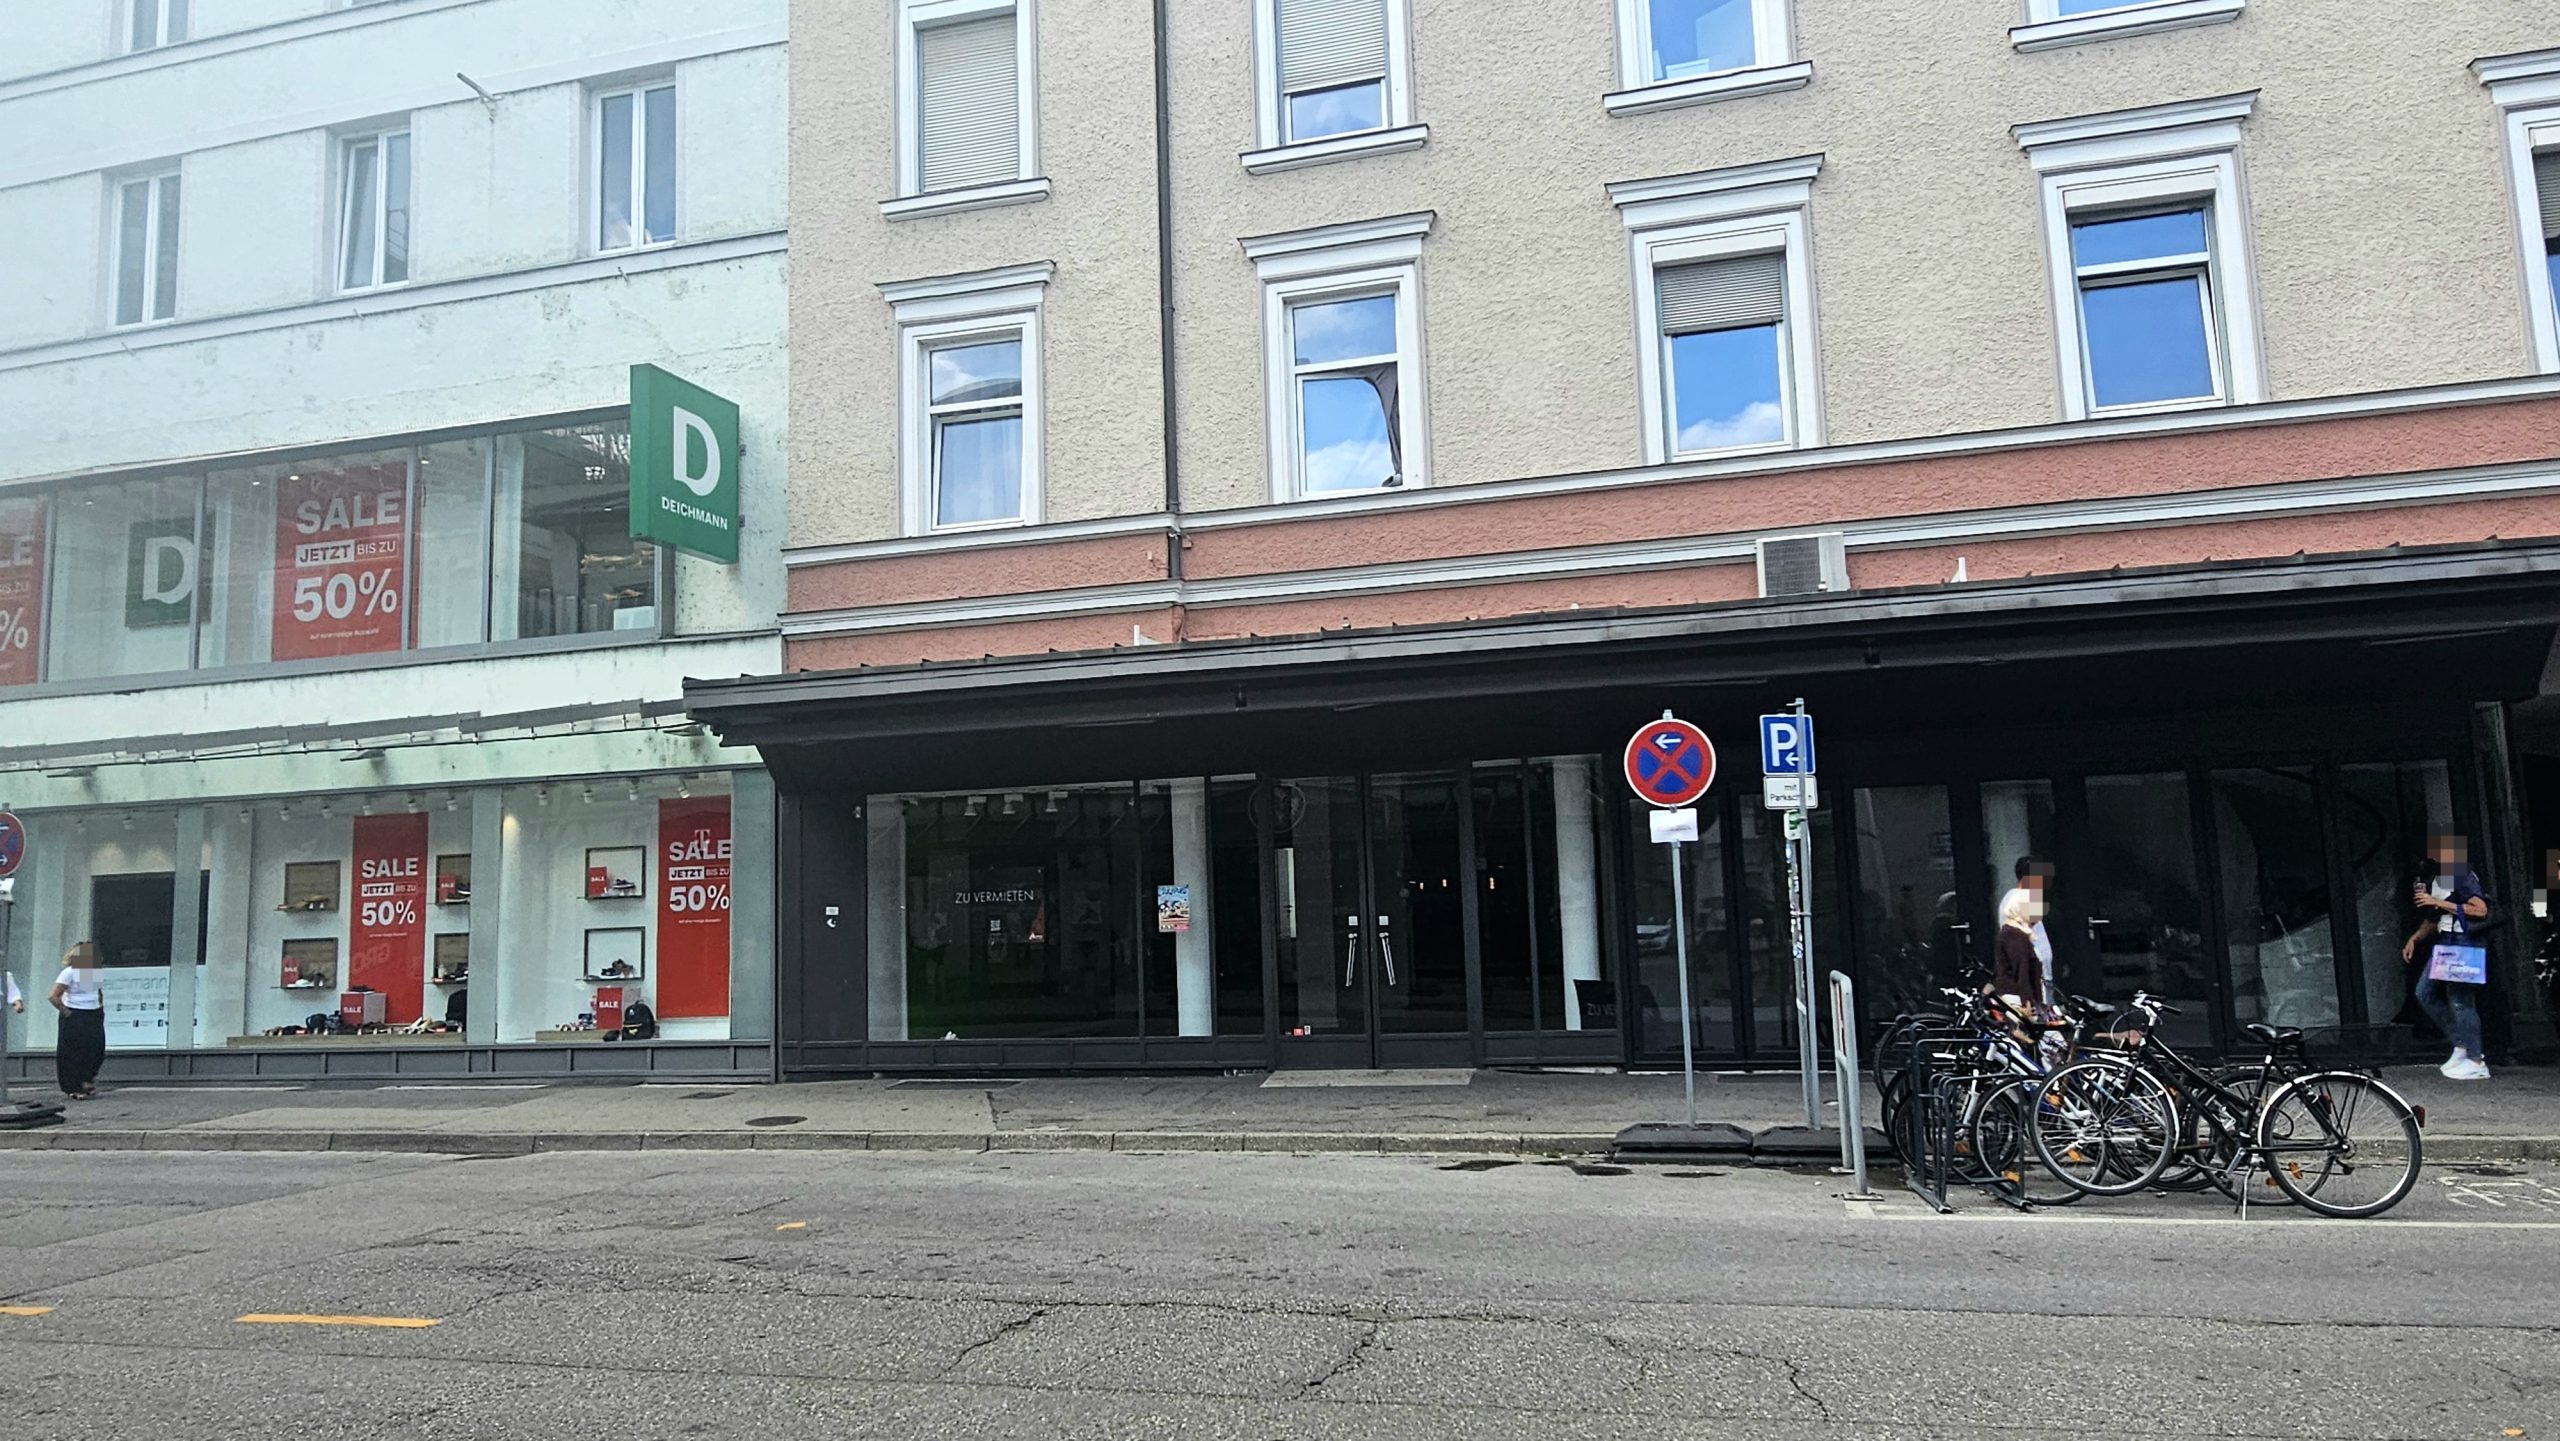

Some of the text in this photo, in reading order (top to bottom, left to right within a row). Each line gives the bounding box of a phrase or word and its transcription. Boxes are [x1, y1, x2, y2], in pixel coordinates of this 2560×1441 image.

[673, 406, 721, 497] D
[296, 490, 401, 535] SALE
[661, 496, 728, 531] DEICHMANN
[299, 540, 396, 563] JETZT BIS ZU
[142, 535, 196, 605] D
[293, 568, 398, 623] 50%
[1769, 722, 1798, 767] P
[669, 838, 731, 862] SALE
[361, 857, 419, 879] SALE
[671, 867, 730, 879] JETZT BIS ZU
[363, 884, 393, 895] JETZT
[406, 884, 417, 892] ZU
[669, 884, 730, 912] 50%
[955, 889, 1034, 904] ZU VERMIETEN
[361, 899, 416, 927] 50%
[343, 1005, 363, 1014] SALE
[598, 1000, 620, 1009] SALE
